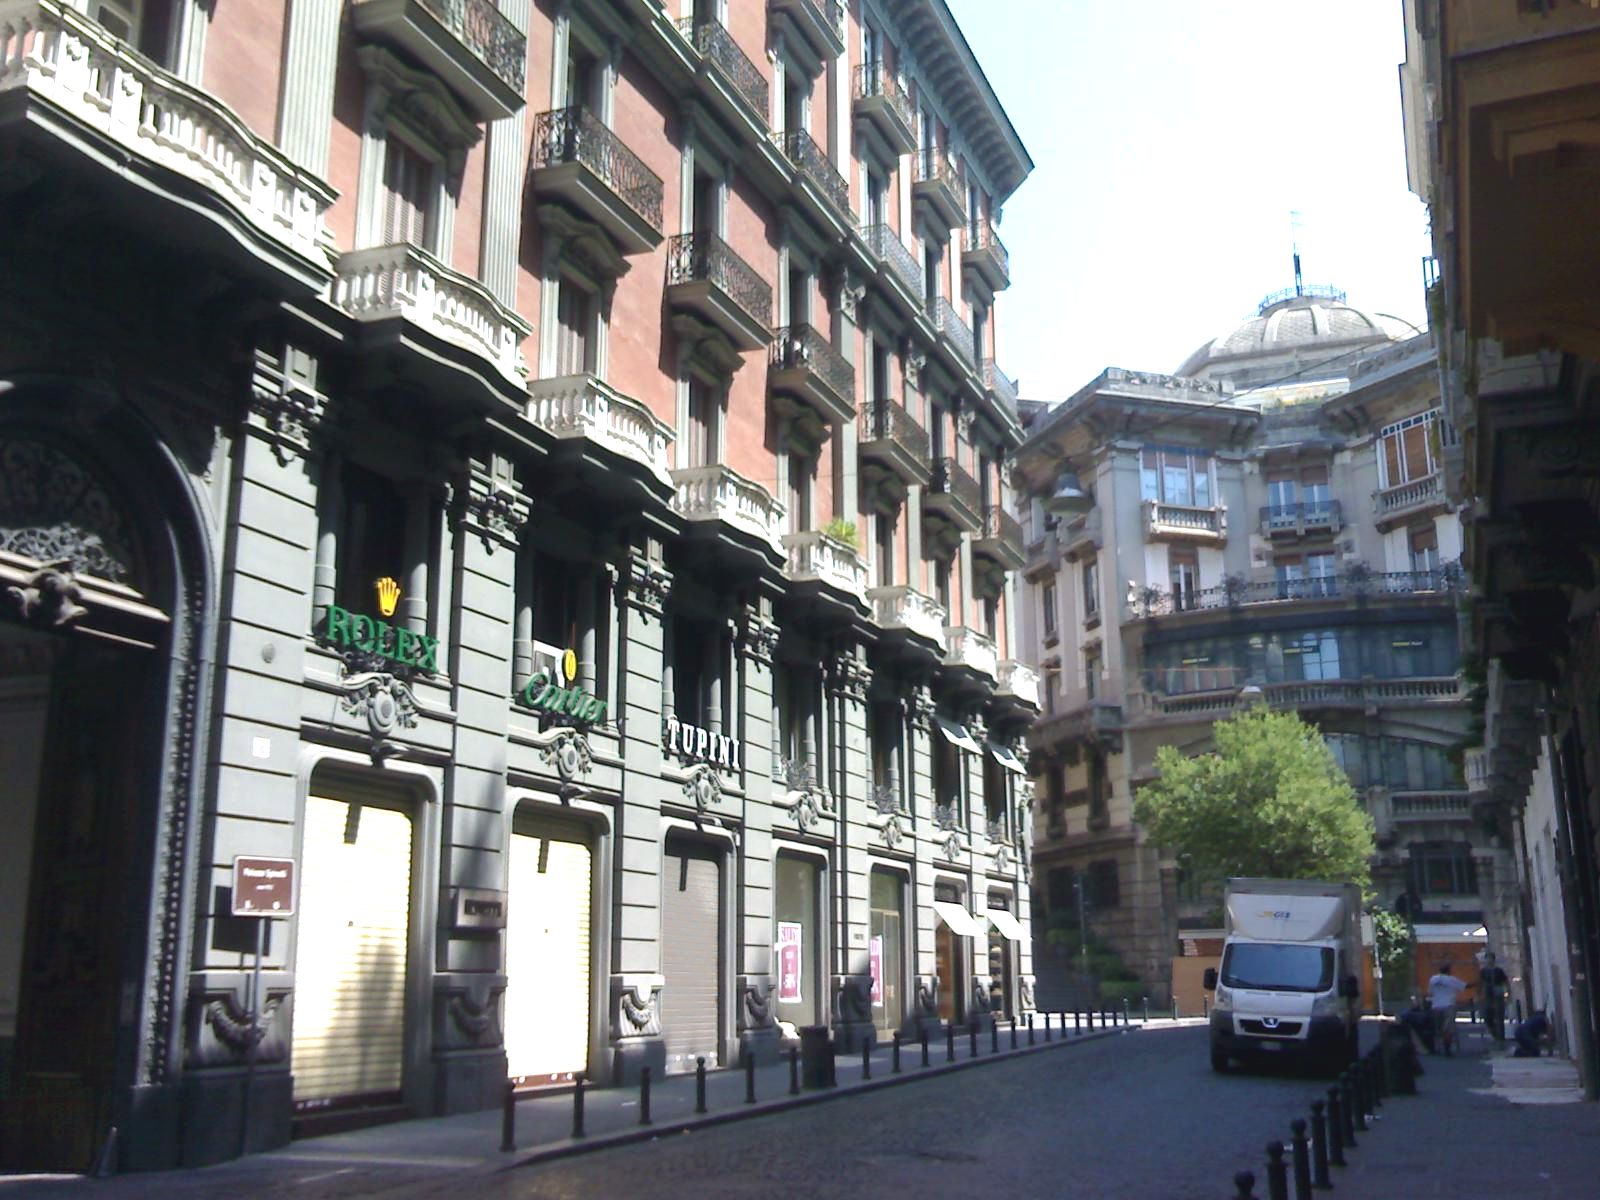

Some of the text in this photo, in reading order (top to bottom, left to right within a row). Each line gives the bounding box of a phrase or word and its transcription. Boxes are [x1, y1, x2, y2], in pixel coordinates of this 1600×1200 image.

[325, 604, 440, 673] ROLEX
[525, 671, 608, 722] Cartier
[666, 717, 741, 768] TUPINI
